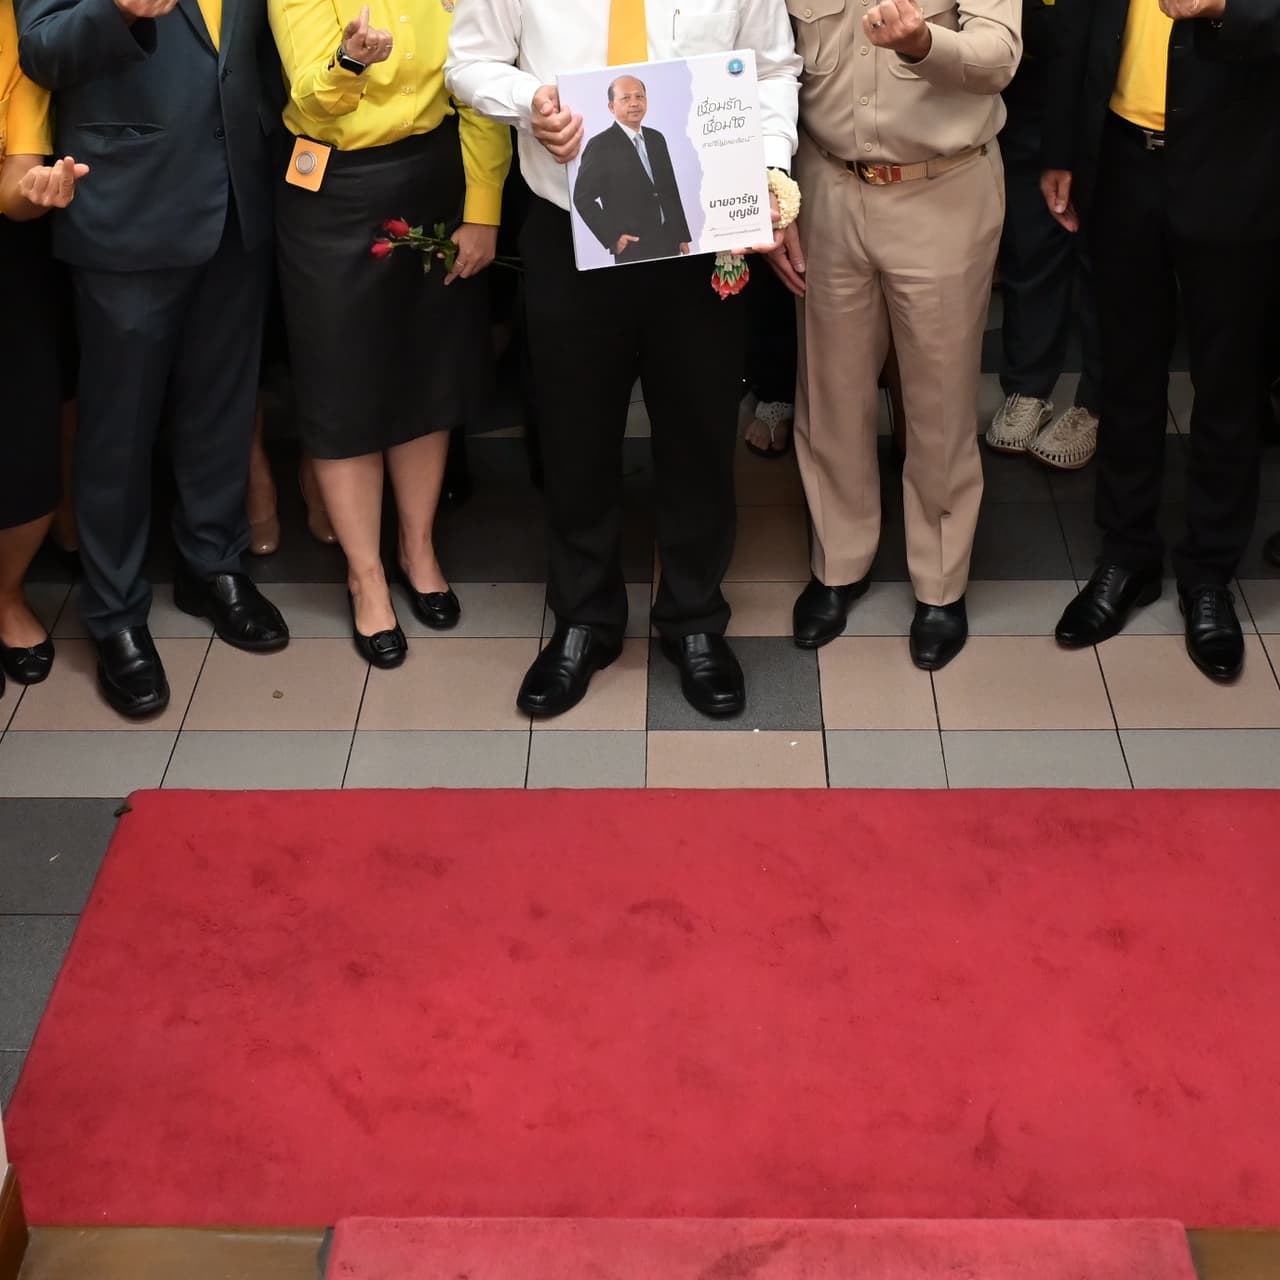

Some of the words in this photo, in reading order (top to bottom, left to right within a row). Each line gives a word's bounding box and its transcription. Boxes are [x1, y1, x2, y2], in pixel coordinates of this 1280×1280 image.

[709, 193, 759, 209] นายอารัญ
[728, 205, 760, 221] บุญชัย
